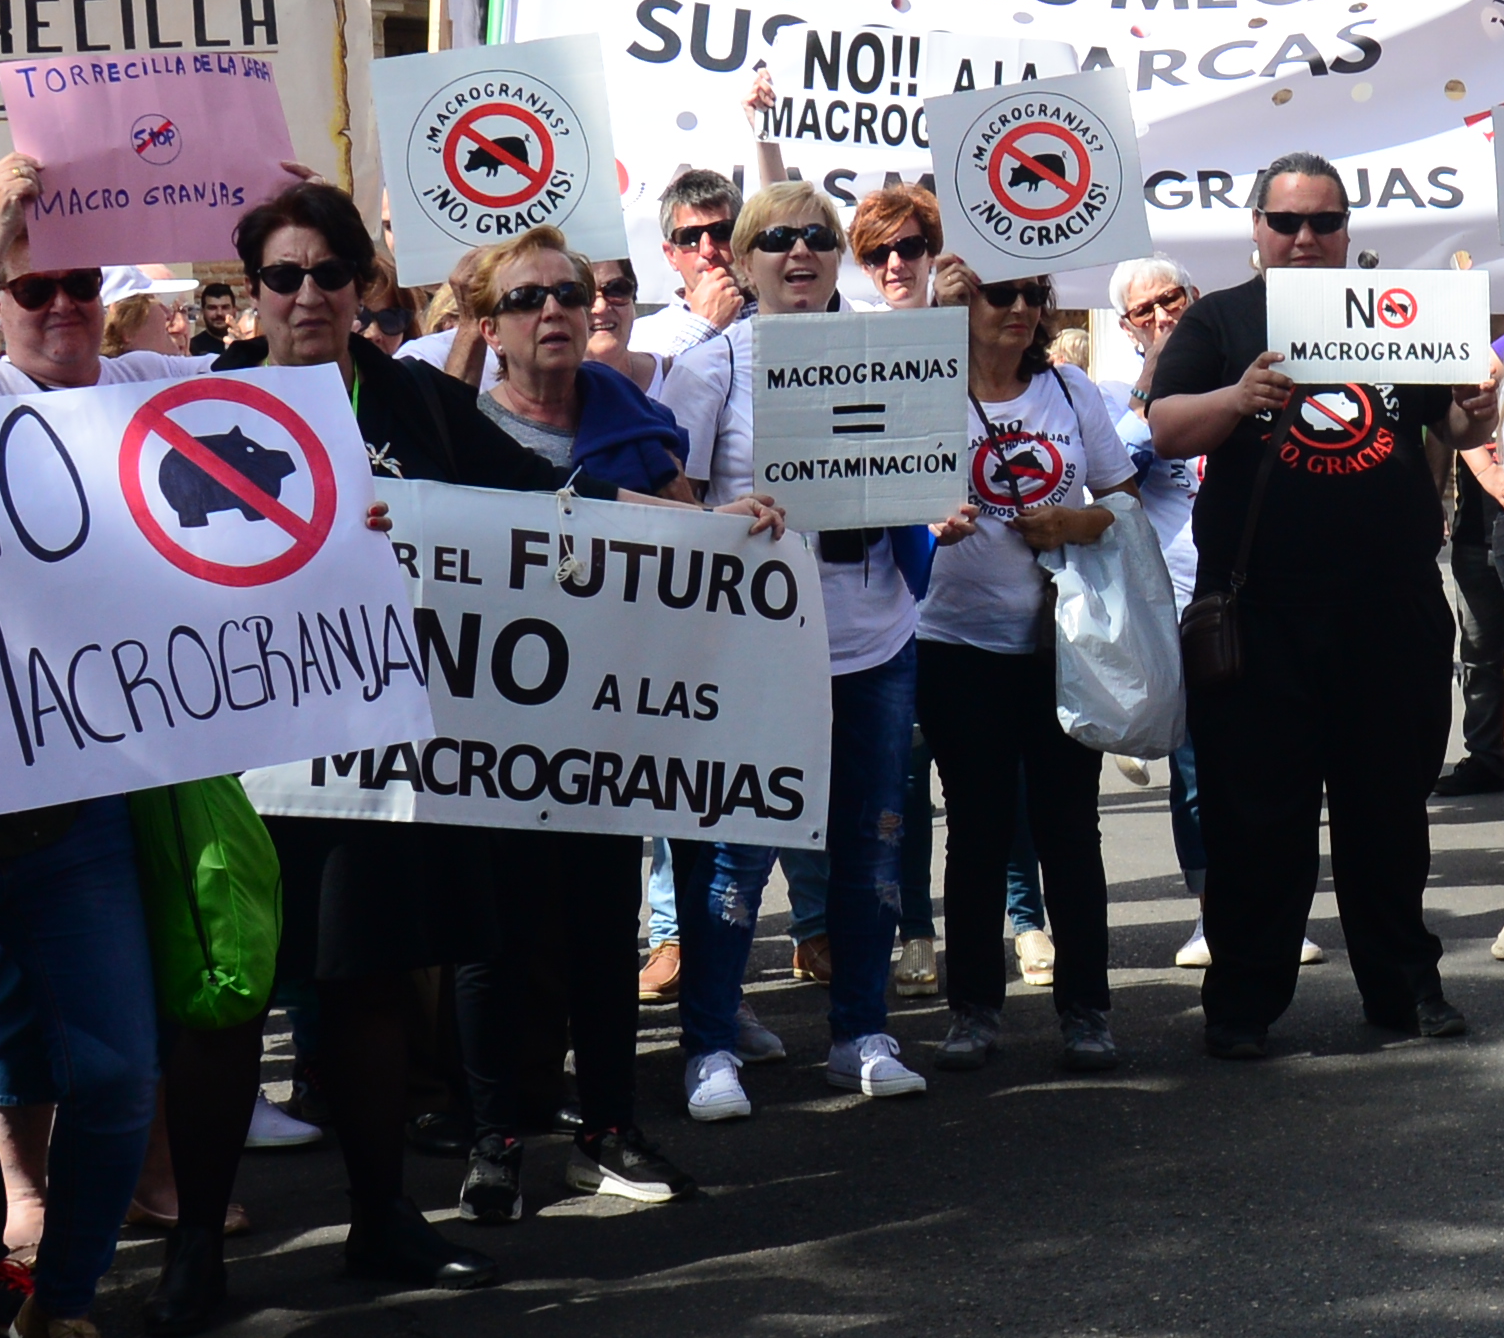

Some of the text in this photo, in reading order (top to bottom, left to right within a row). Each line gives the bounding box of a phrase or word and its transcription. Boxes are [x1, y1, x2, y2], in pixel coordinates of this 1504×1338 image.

[804, 29, 921, 96] NO!!
[426, 82, 570, 154] ¿MACROGRANJAS?
[972, 103, 1104, 171] ¿MACROGRANJAS?
[34, 188, 130, 220] MACRO
[475, 169, 575, 235] GRACIAS!
[1019, 182, 1110, 247] GRACIAS!
[767, 358, 959, 390] MACROGRANJAS
[1290, 342, 1470, 364] MACROGRANJAS
[765, 441, 958, 483] CONTAMINACIÓN
[1307, 427, 1395, 475] GRACIAS!
[434, 545, 482, 586] EL
[509, 528, 806, 627] FUTURO,
[413, 607, 720, 721] NO A LAS
[311, 737, 805, 828] MACROGRANJAS
